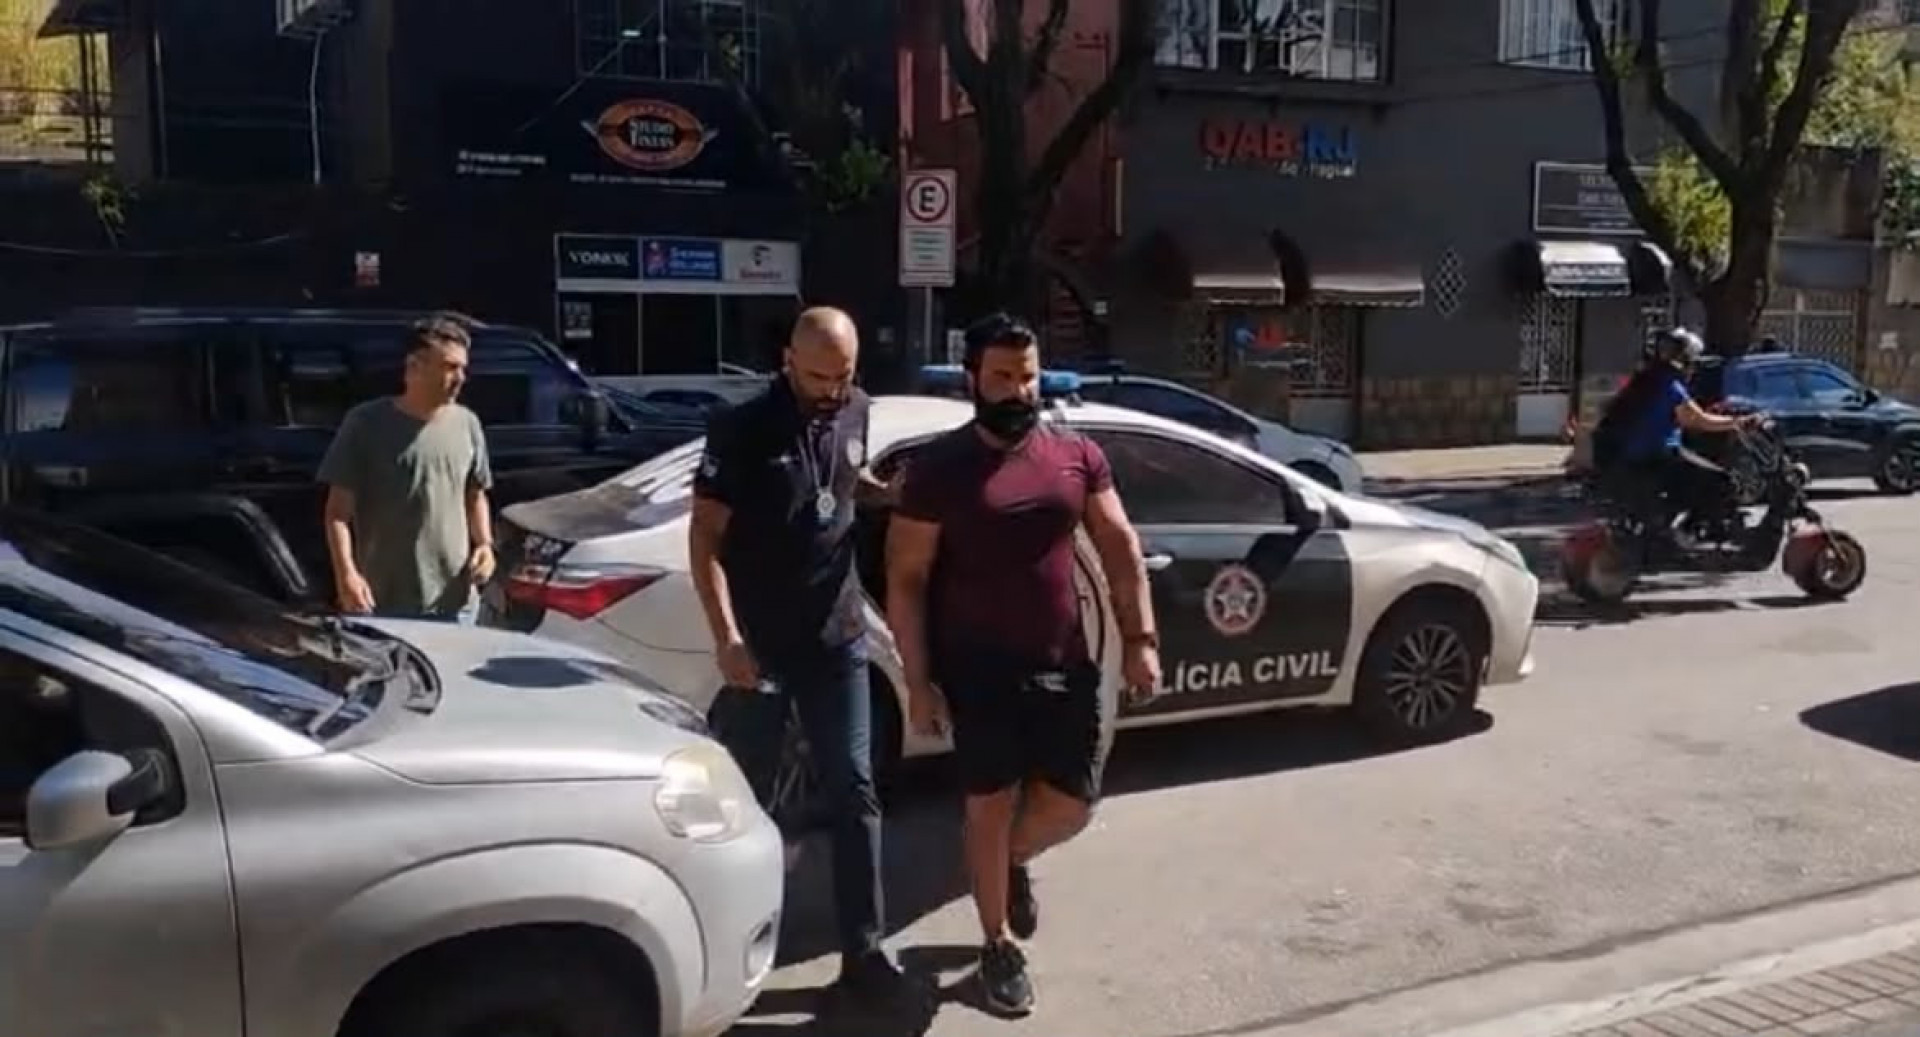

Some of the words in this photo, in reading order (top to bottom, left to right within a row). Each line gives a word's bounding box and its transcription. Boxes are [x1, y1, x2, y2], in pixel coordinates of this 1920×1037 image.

[920, 186, 937, 212] E
[1157, 660, 1243, 694] LÍCIA
[1253, 651, 1338, 682] CIVIL
